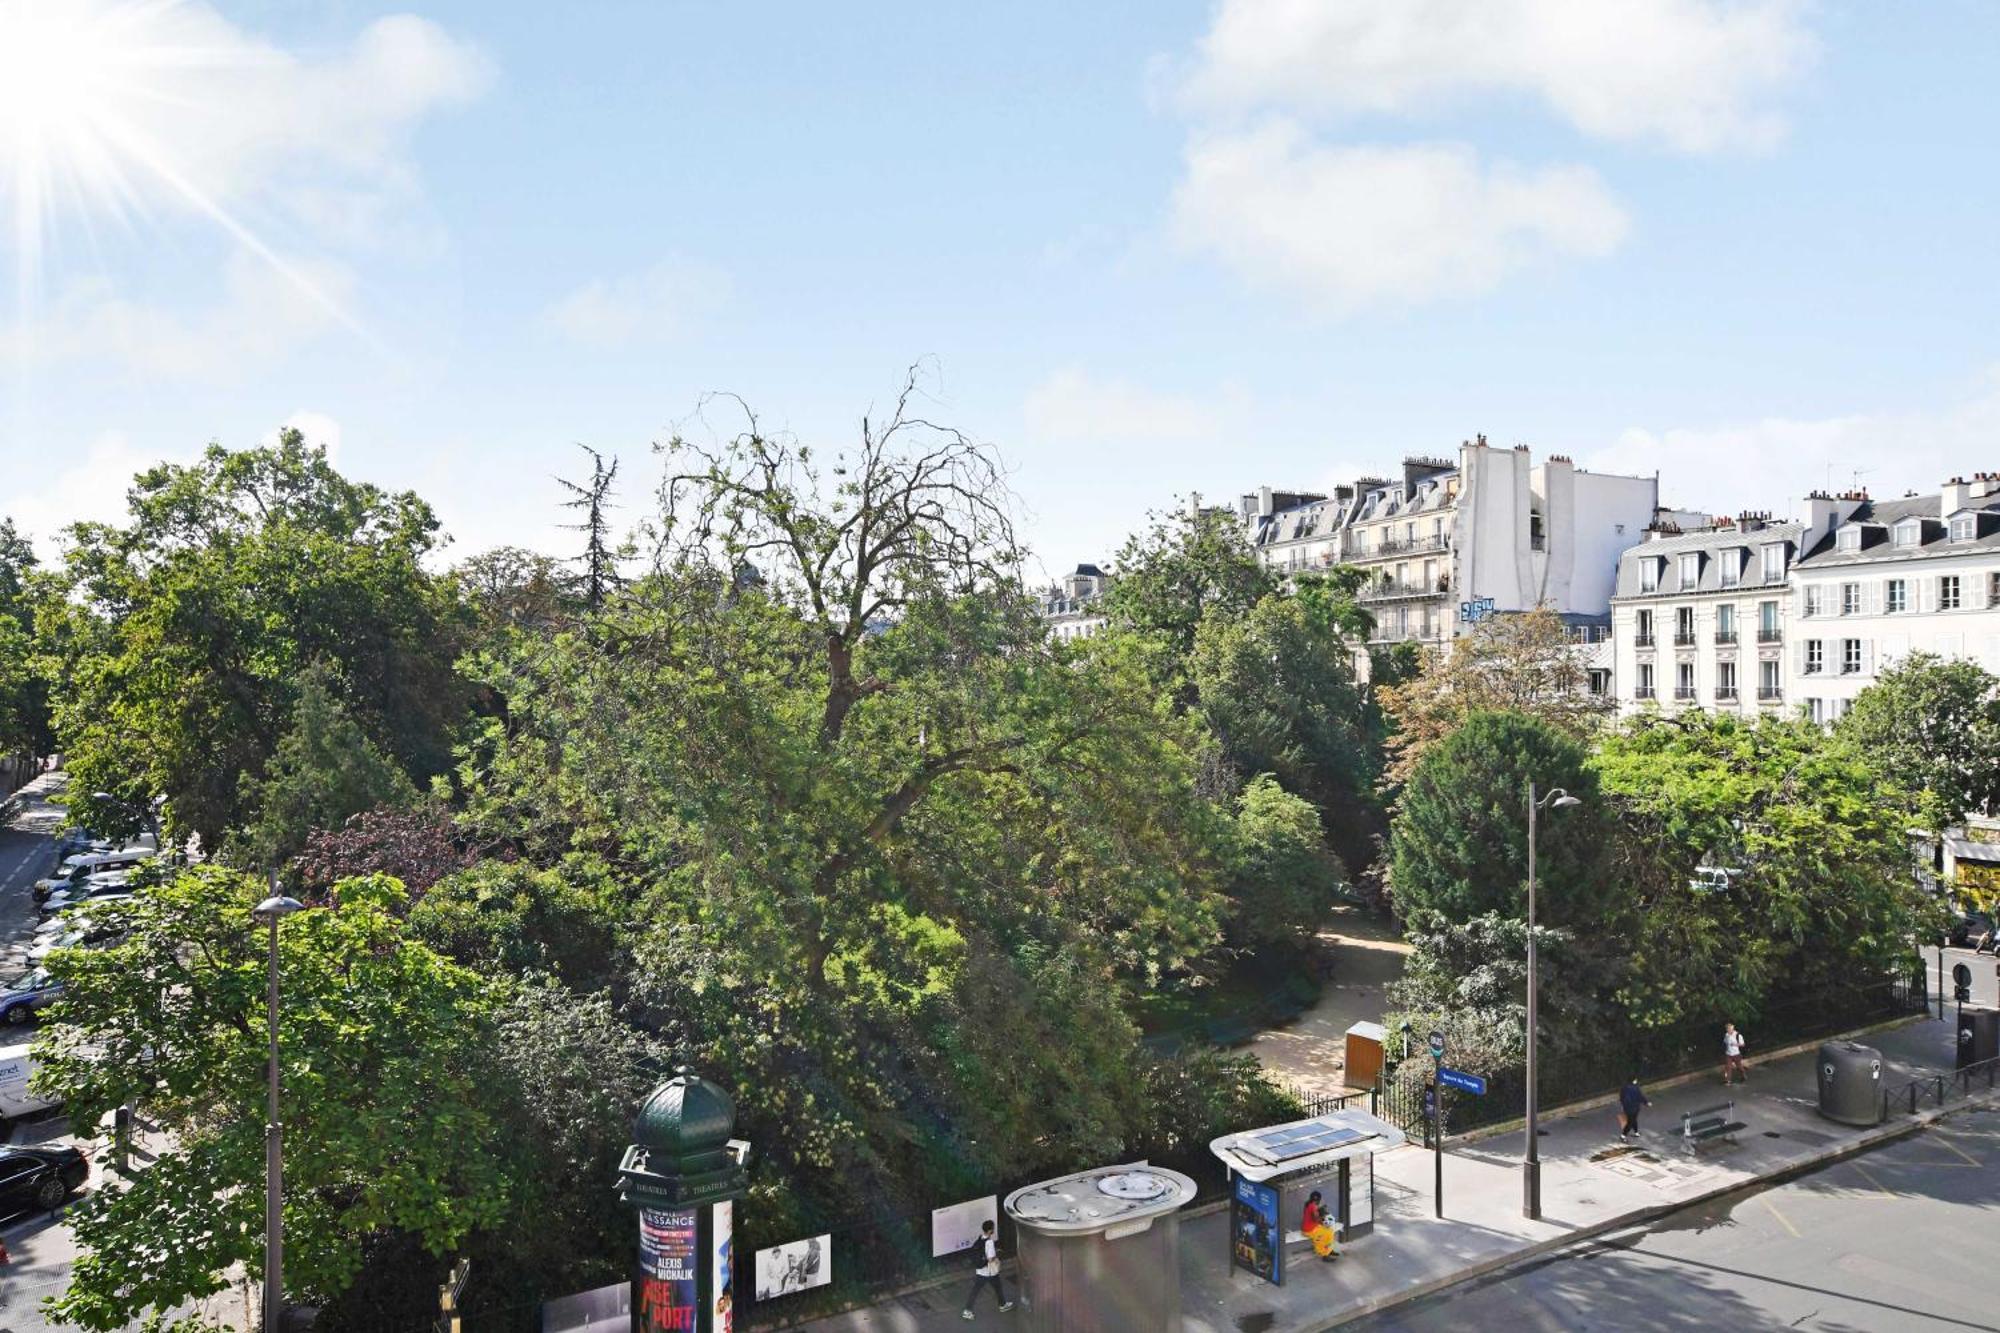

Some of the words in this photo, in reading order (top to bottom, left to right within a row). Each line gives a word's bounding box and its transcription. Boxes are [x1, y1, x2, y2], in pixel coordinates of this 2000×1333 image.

[657, 1257, 682, 1269] ALEXIS
[658, 1269, 693, 1280] MICHALIK
[653, 1305, 693, 1329] PORT
